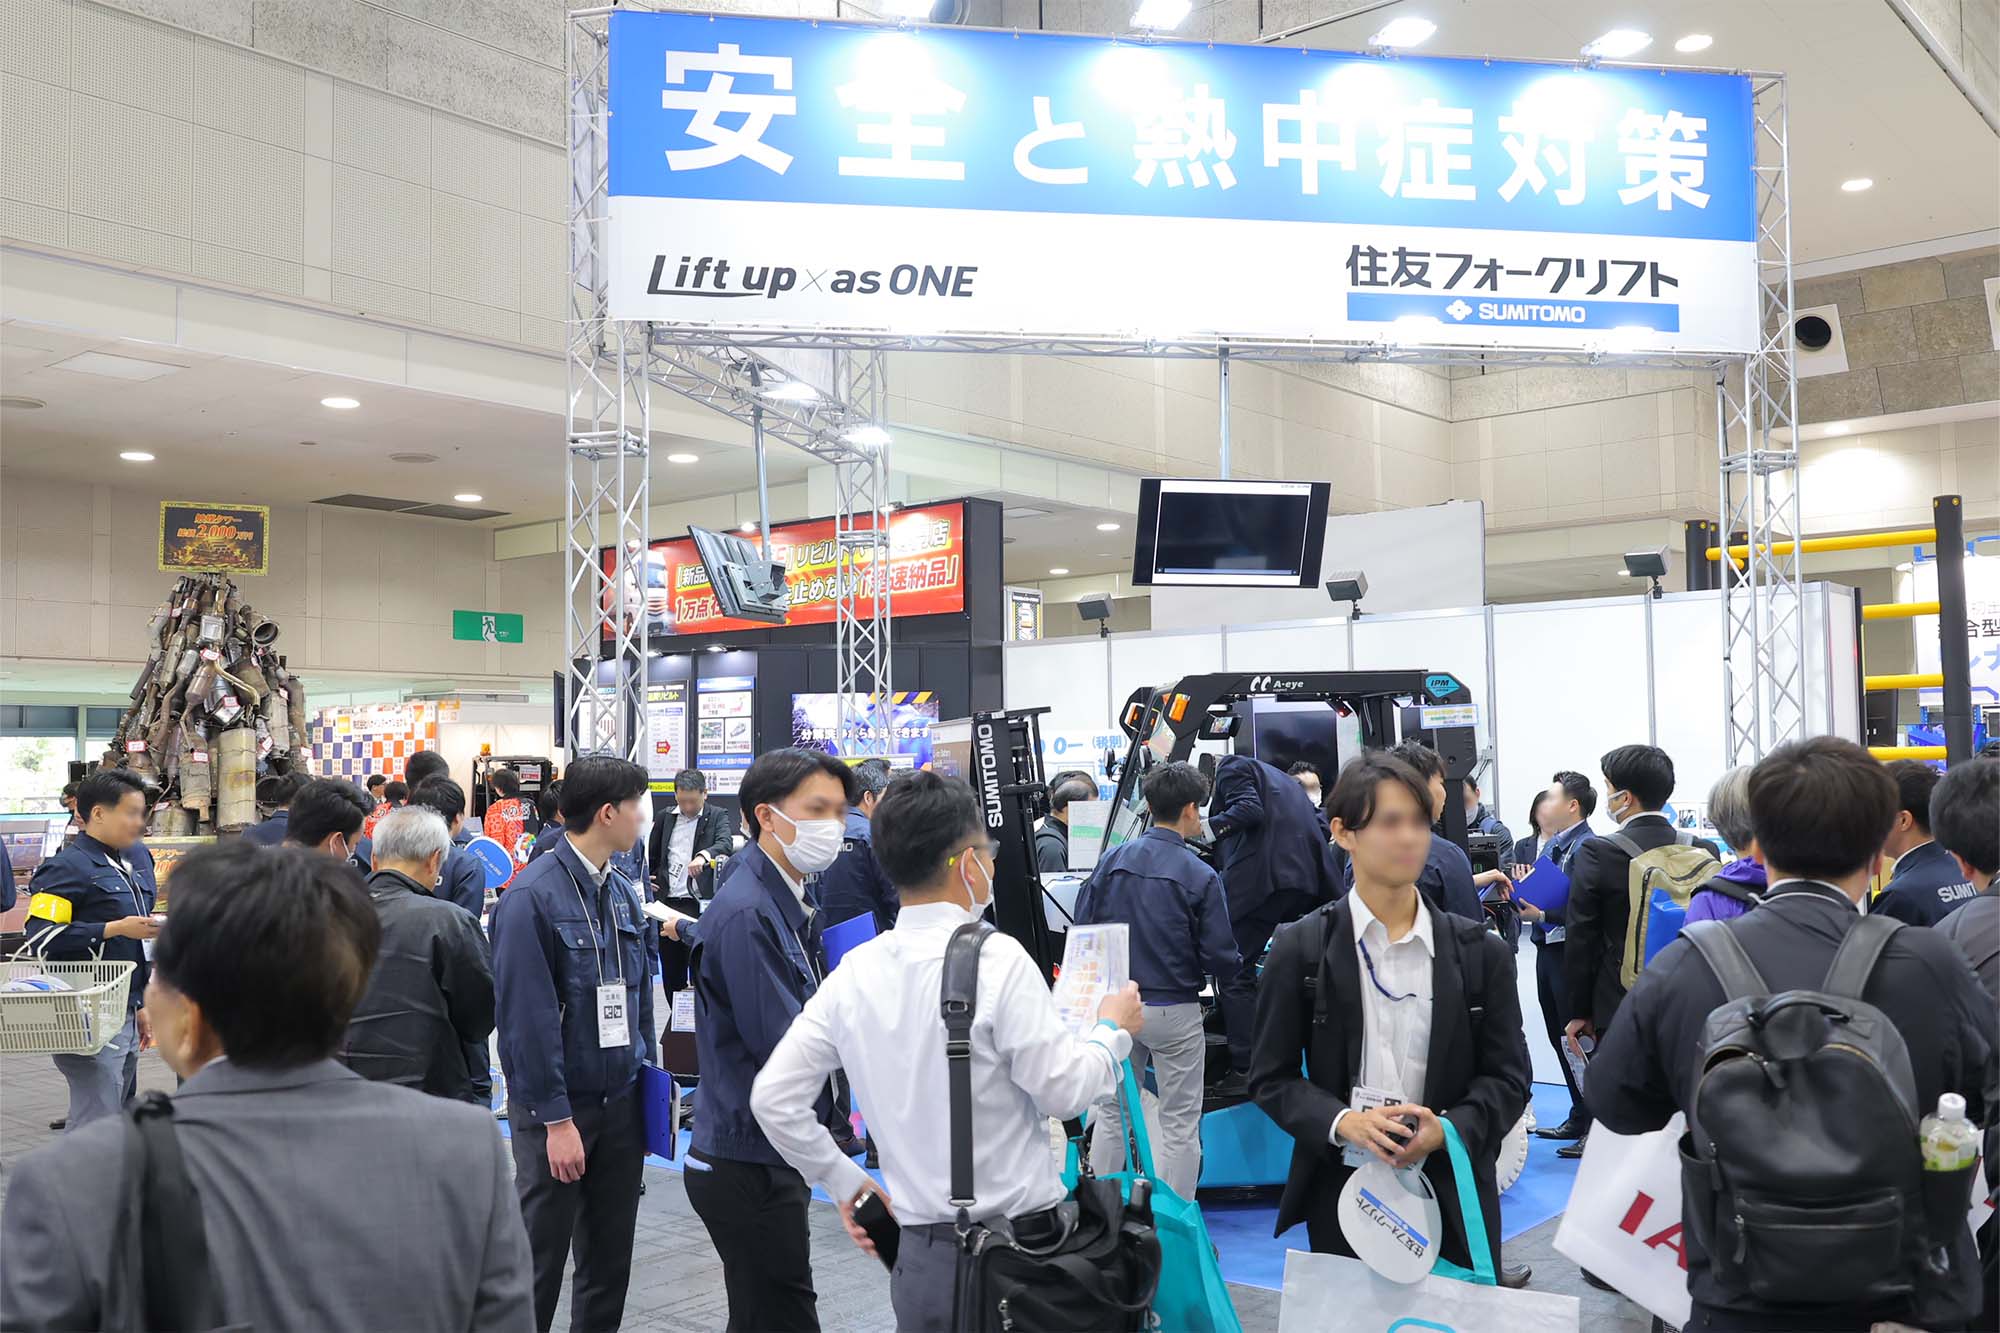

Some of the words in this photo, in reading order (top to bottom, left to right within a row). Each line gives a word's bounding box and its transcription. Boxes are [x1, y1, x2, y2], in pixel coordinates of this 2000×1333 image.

[661, 43, 1711, 211] 安全と熱中症対策
[647, 254, 730, 297] Lift
[741, 267, 797, 298] up
[831, 269, 881, 295] as
[889, 263, 978, 298] ONE
[1346, 244, 1680, 298] 住友フォークリフト
[1478, 303, 1586, 323] SUMITOMO
[977, 724, 1004, 828] SUMITOMO
